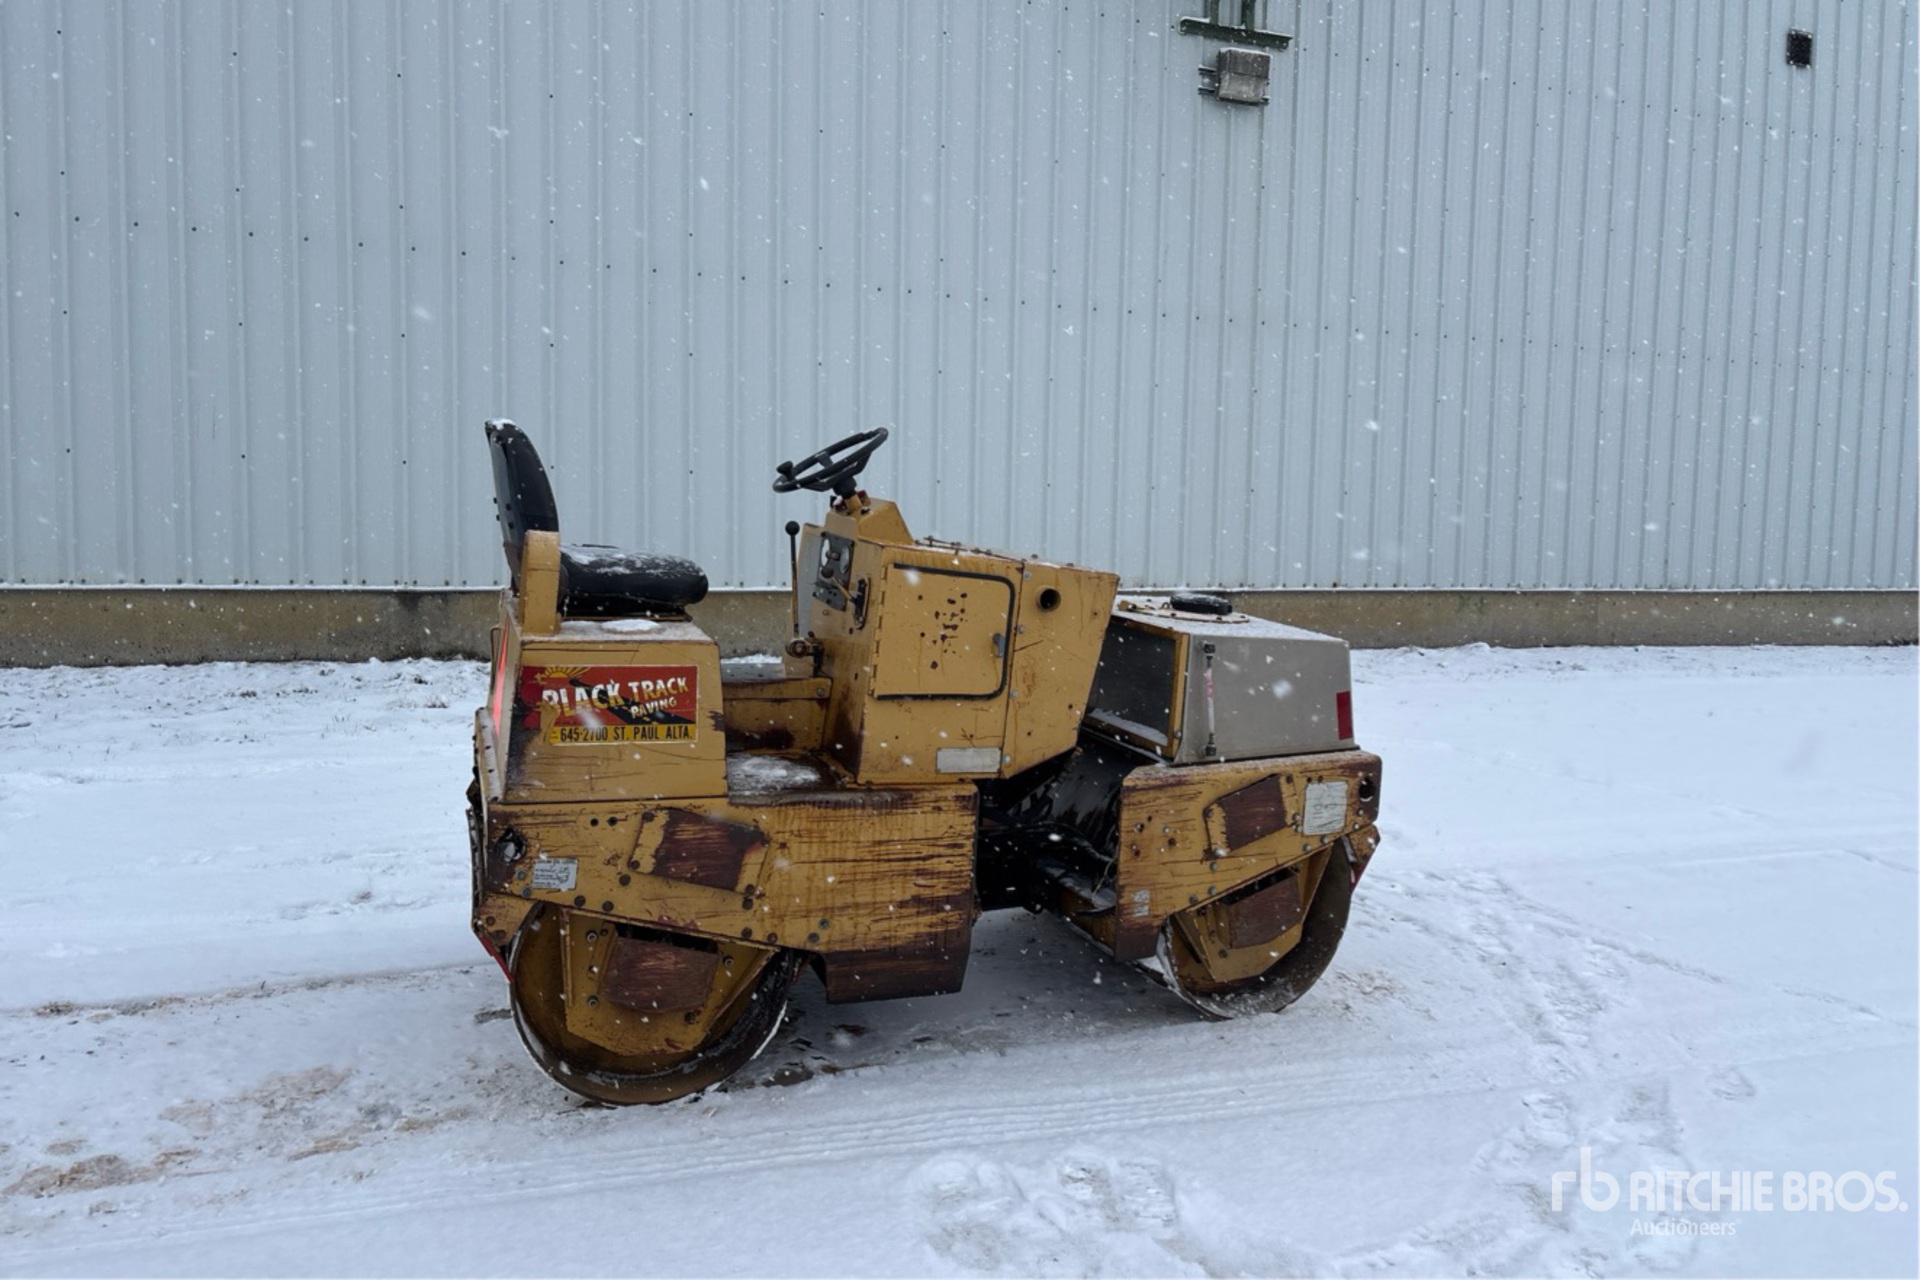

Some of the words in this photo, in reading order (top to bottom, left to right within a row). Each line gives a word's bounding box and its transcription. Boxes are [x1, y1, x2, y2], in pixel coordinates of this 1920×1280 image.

[628, 677, 689, 702] TRACK
[630, 696, 677, 719] PAVING
[613, 726, 629, 741] ST.
[633, 725, 660, 740] PAUL
[665, 725, 693, 740] ALTA.
